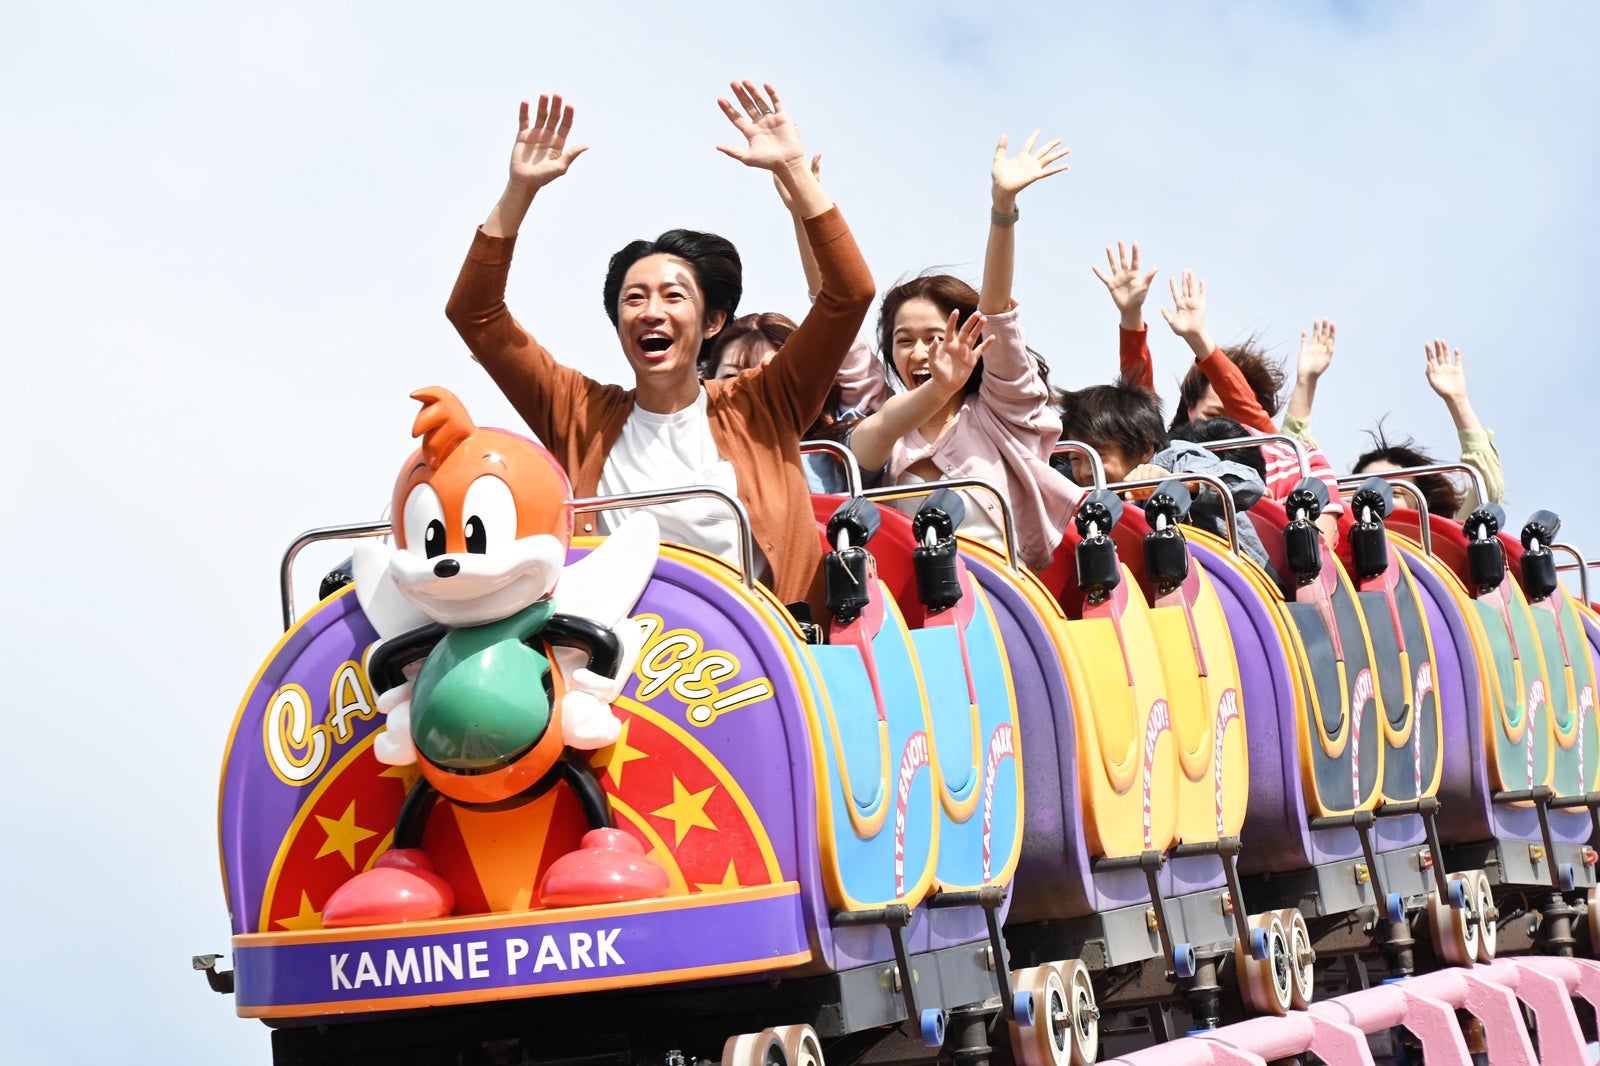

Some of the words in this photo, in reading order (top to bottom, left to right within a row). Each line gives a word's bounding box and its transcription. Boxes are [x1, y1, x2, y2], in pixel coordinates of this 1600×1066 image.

[1146, 702, 1169, 764] ENJOY!
[1219, 691, 1238, 727] PARK
[1353, 672, 1374, 733] ENJOY!
[899, 735, 929, 806] ENJOY!
[983, 755, 996, 879] KAMINE
[992, 727, 1014, 760] PARK
[1143, 766, 1151, 844] LET'S
[1215, 717, 1224, 832] KAMINE
[895, 808, 905, 895] LET'S
[330, 941, 490, 991] KAMINE
[506, 928, 626, 976] PARK
